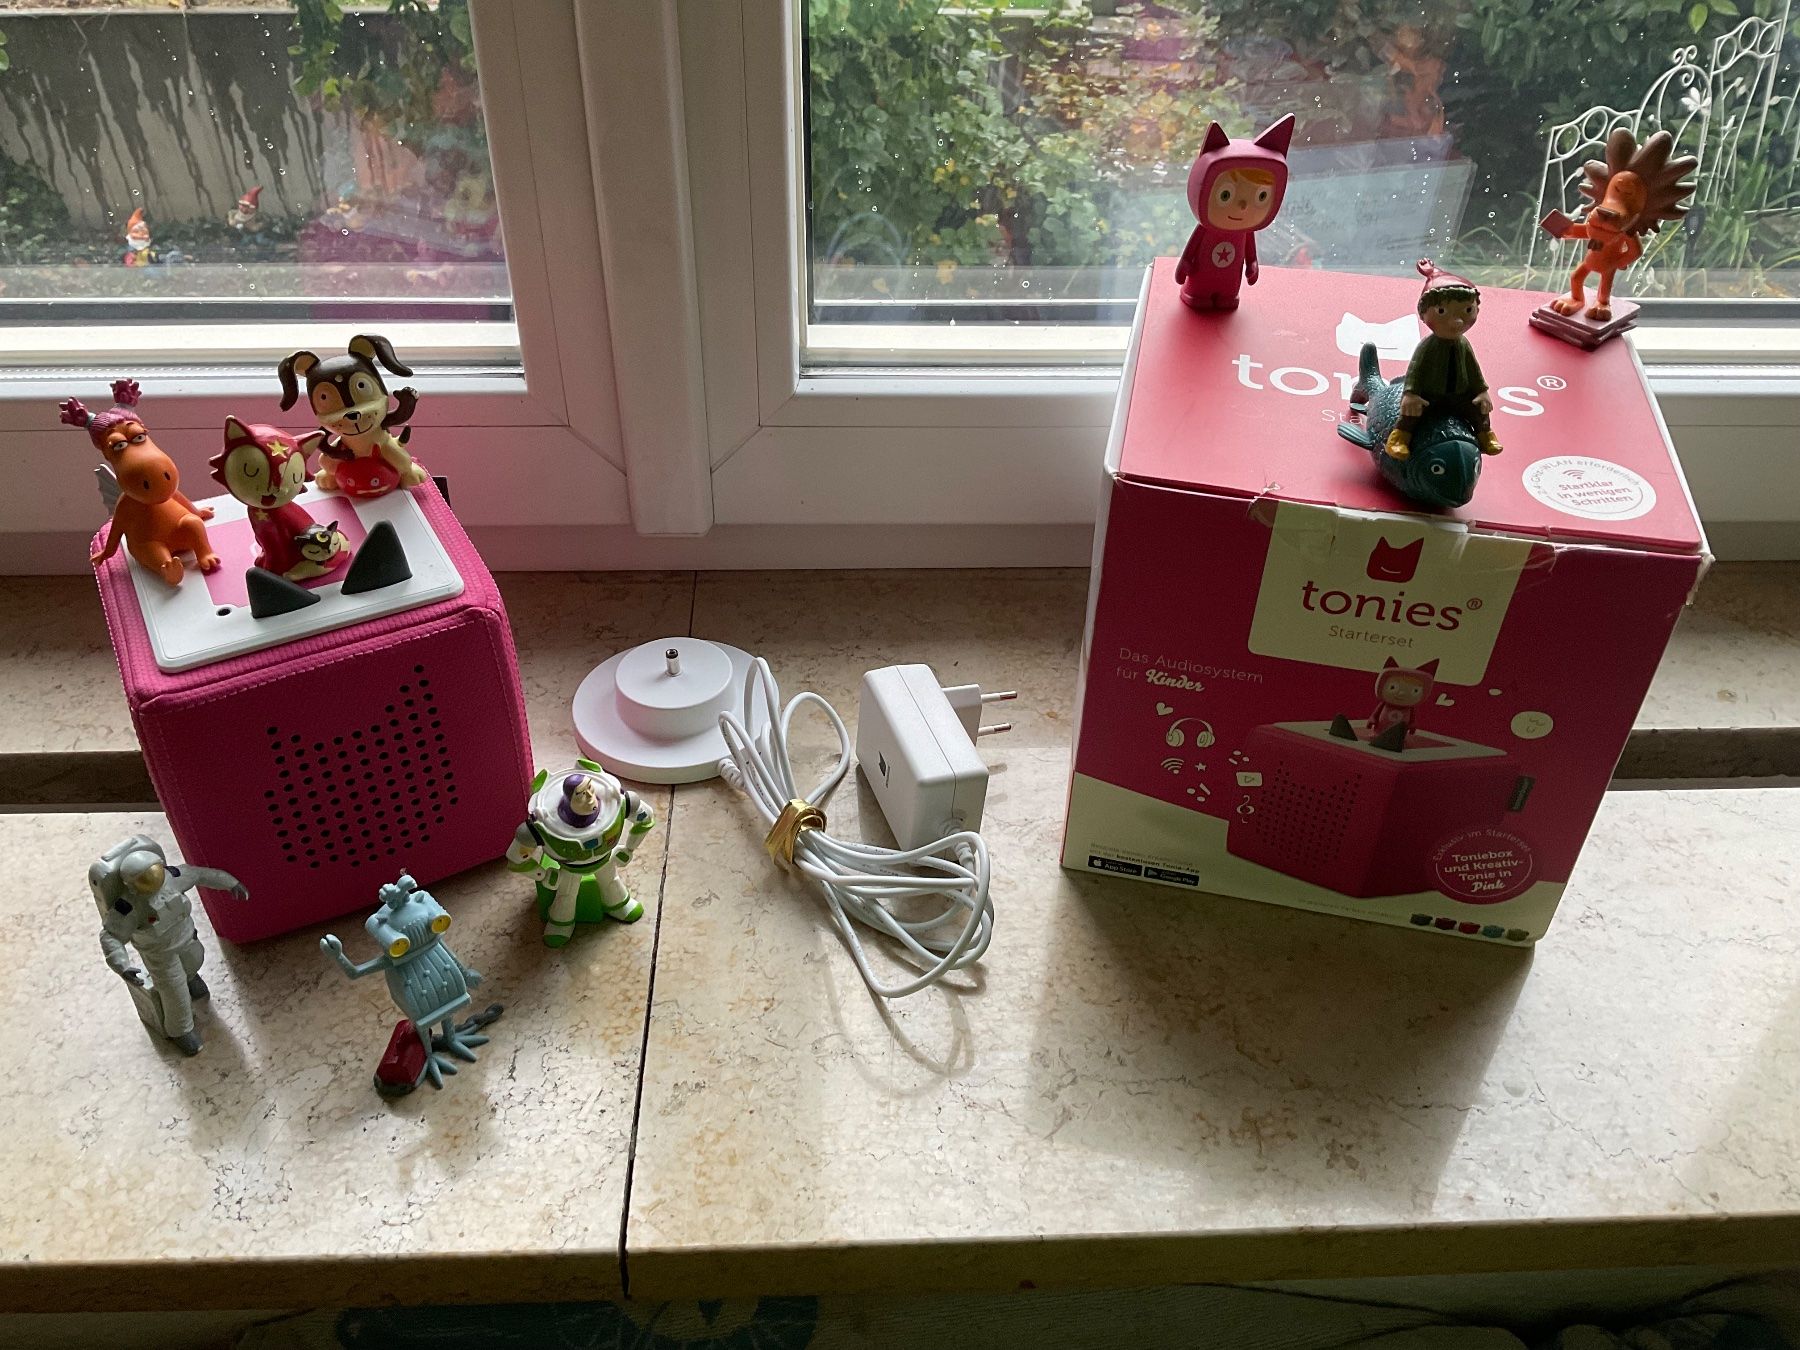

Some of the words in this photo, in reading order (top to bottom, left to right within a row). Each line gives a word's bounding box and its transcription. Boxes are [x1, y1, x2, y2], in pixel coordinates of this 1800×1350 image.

[1558, 480, 1614, 491] Startklar
[1574, 487, 1632, 498] wenigen
[1571, 495, 1633, 506] Schritten
[1328, 625, 1414, 648] Starterset
[1119, 647, 1149, 664] Das
[1154, 654, 1263, 684] Audiosystem
[1116, 666, 1138, 680] für
[1145, 668, 1205, 692] Kinder
[1452, 850, 1513, 863] Toniebox
[1104, 863, 1119, 872] App
[1444, 863, 1470, 873] und
[1459, 872, 1496, 881] Tonie
[1499, 870, 1512, 878] in
[1470, 879, 1506, 893] Pink
